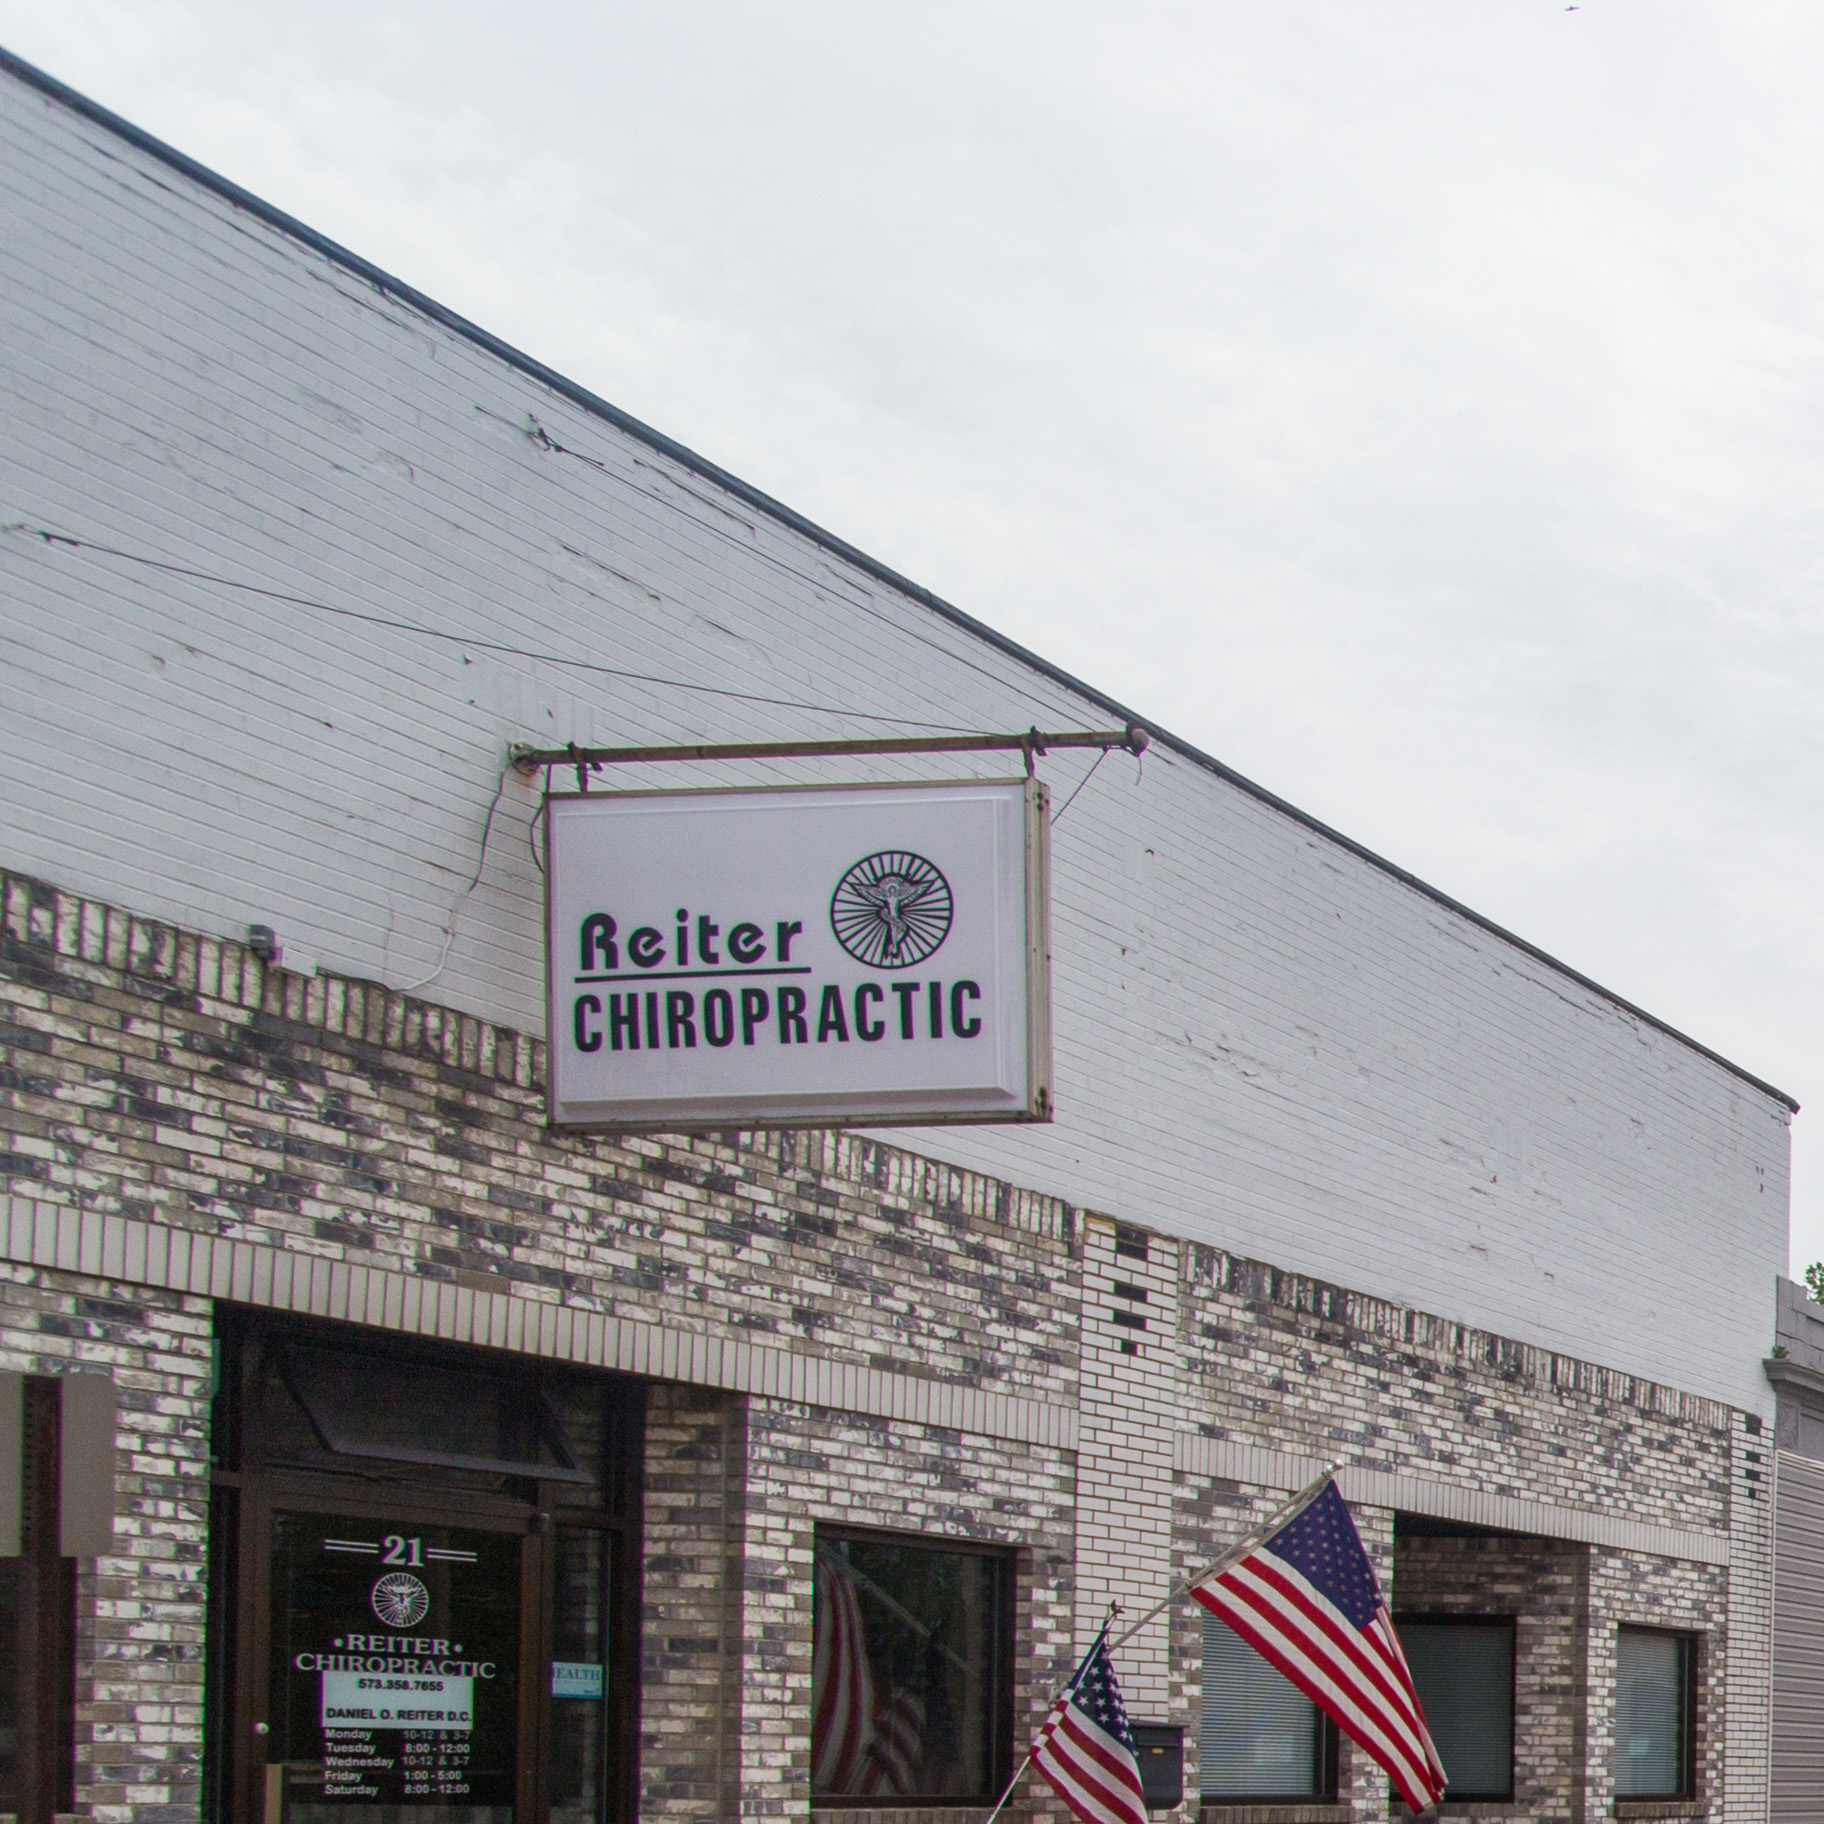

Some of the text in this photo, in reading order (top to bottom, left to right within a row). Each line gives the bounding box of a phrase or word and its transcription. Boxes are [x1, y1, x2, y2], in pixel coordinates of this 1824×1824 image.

[579, 907, 803, 971] Reiter
[574, 980, 983, 1053] CHIROPRACTIC
[381, 1535, 425, 1567] 21
[346, 1634, 452, 1656] REITER
[296, 1653, 496, 1679] CHIROPRACTIC
[358, 1678, 444, 1692] 573.358.7655
[326, 1707, 472, 1722] DANIEL O. REITER D.C.
[325, 1729, 372, 1741] Monday
[403, 1731, 434, 1740] 10-12
[326, 1743, 376, 1755] Tuesday
[440, 1744, 470, 1754] 12:00
[325, 1757, 395, 1769] Wednesday
[402, 1756, 433, 1766] 10-12
[452, 1756, 470, 1766] 3-7
[325, 1771, 362, 1783] Friday
[325, 1785, 378, 1797] Saturday
[439, 1785, 470, 1794] 12:00
